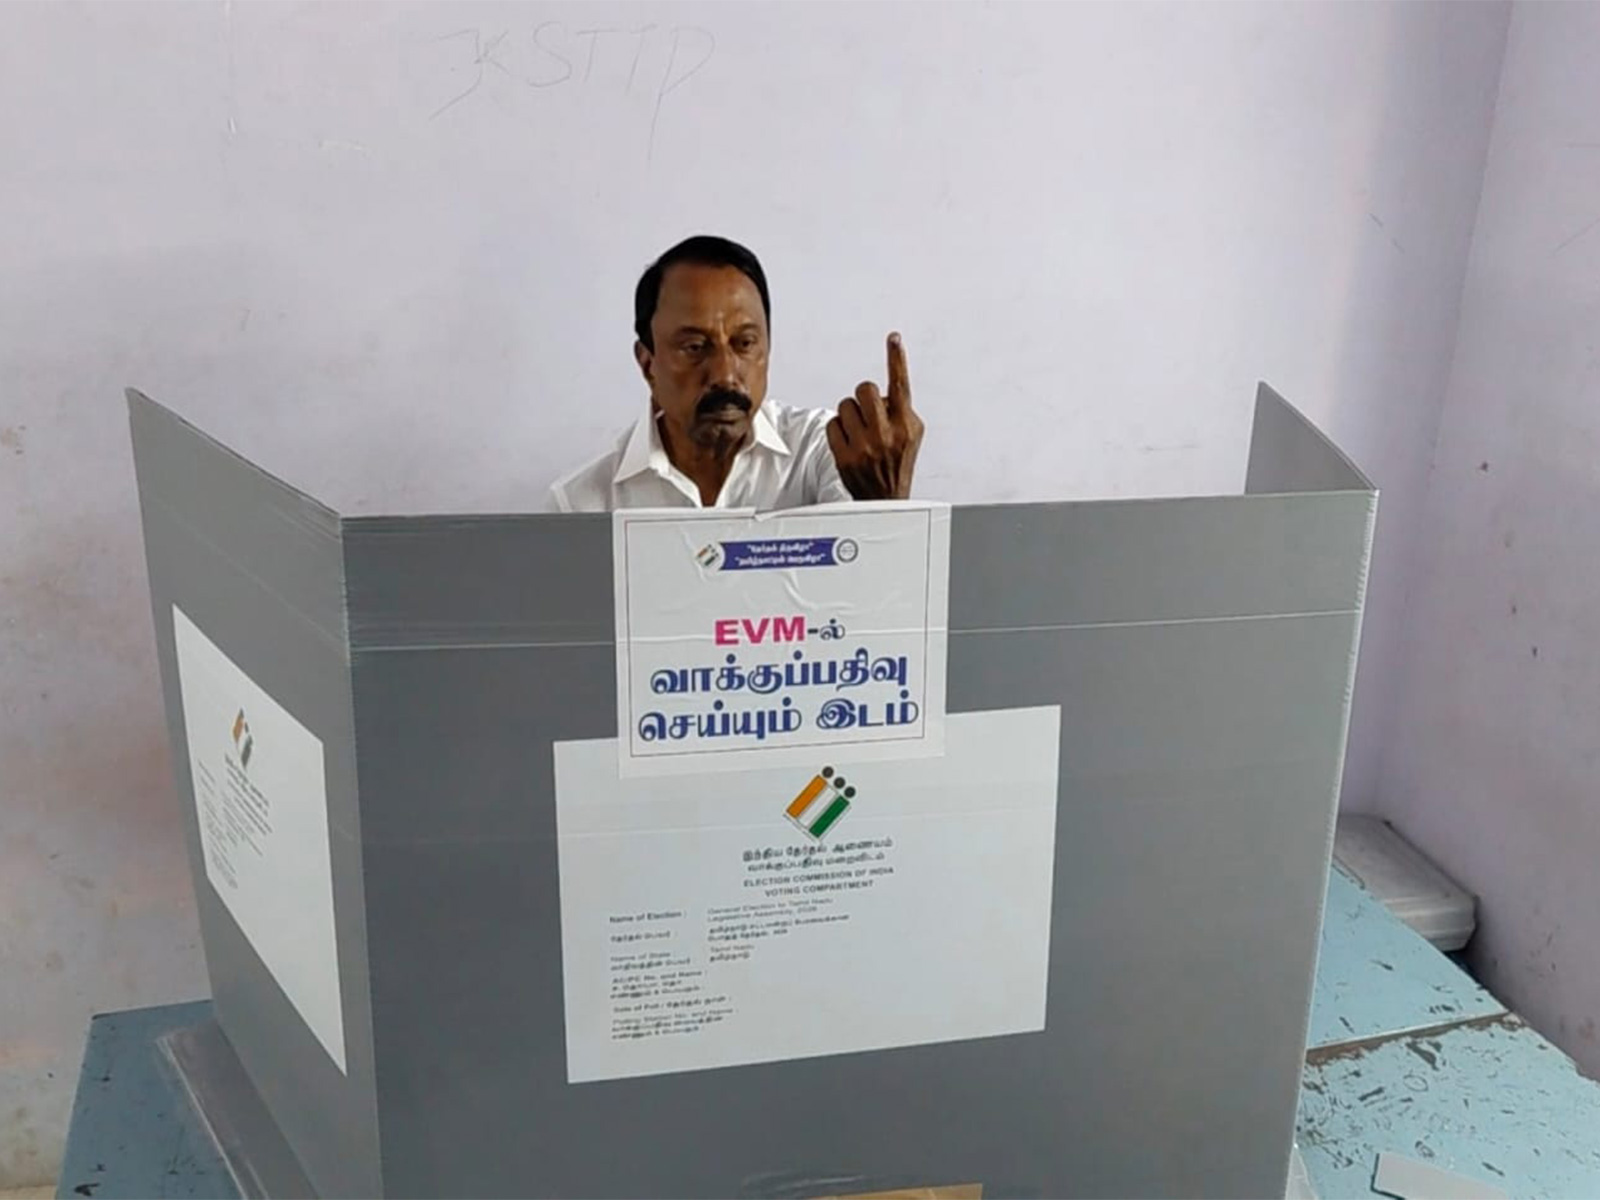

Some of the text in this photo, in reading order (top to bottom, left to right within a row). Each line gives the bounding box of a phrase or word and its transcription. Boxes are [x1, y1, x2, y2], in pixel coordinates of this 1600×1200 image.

[650, 647, 908, 695] வாக்குப்பதிவு
[638, 689, 920, 742] செய்யும் இடம்
[786, 843, 828, 858] தேர்தல்
[743, 866, 895, 888] ELECTION COMMISSION OF INDIA
[764, 879, 874, 898] VOTING COMPARTMENT
